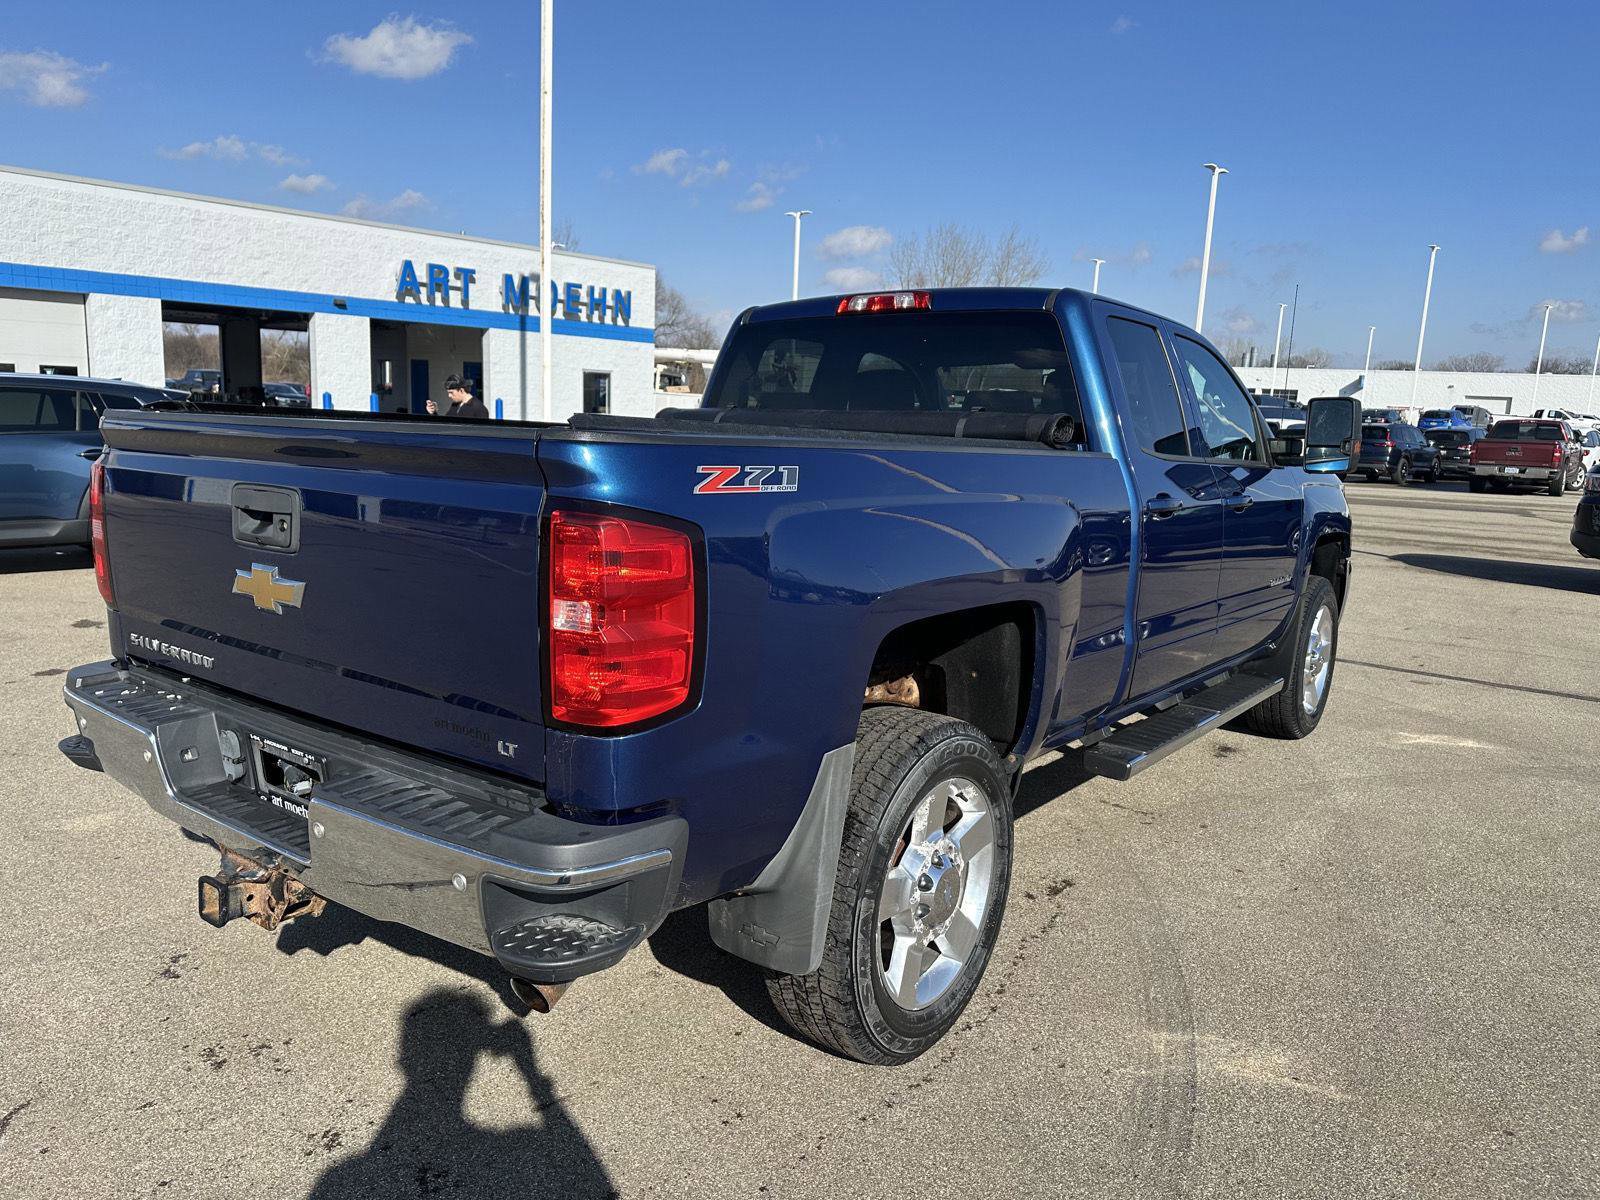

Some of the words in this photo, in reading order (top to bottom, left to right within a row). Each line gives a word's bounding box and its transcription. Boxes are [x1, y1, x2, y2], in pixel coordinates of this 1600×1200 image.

[397, 259, 476, 306] ART
[693, 465, 799, 494] Z71
[130, 632, 215, 670] SILVERADO
[497, 739, 519, 759] LT
[271, 795, 284, 808] art
[284, 800, 309, 819] moeh
